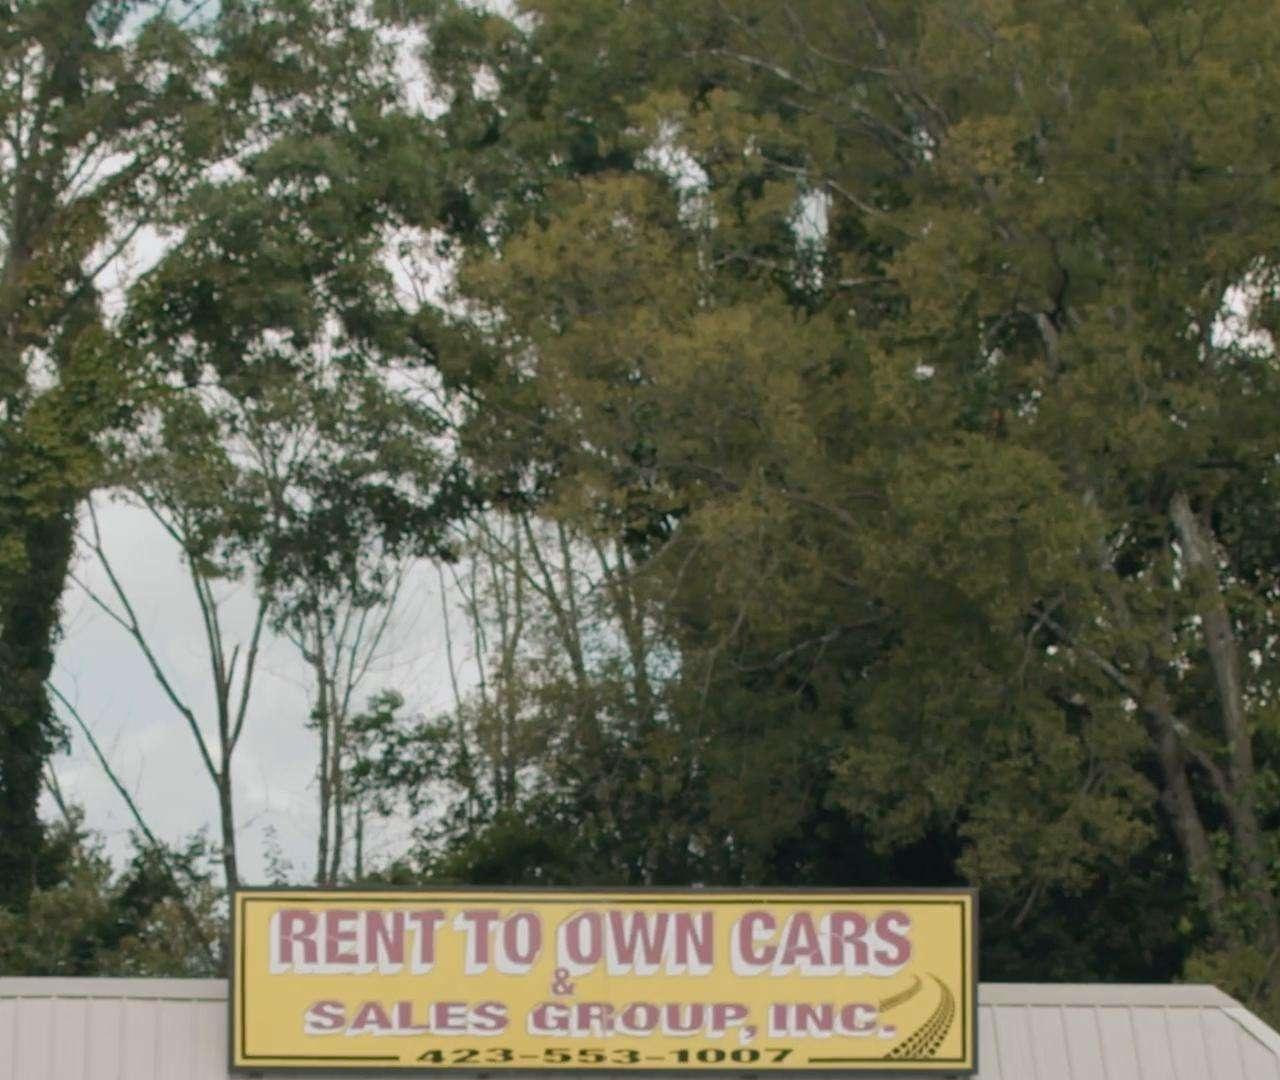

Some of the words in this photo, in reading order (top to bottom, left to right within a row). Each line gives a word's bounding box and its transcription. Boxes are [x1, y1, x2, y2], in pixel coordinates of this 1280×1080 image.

[270, 908, 445, 975] RENT
[453, 908, 542, 975] TO
[557, 908, 714, 977] OWN
[730, 909, 912, 977] CARS
[551, 967, 575, 996] &
[304, 1000, 510, 1037] SALES
[527, 1002, 758, 1045] GROUP,
[768, 1002, 898, 1038] INC.
[417, 1048, 795, 1064] 423-553-1007
